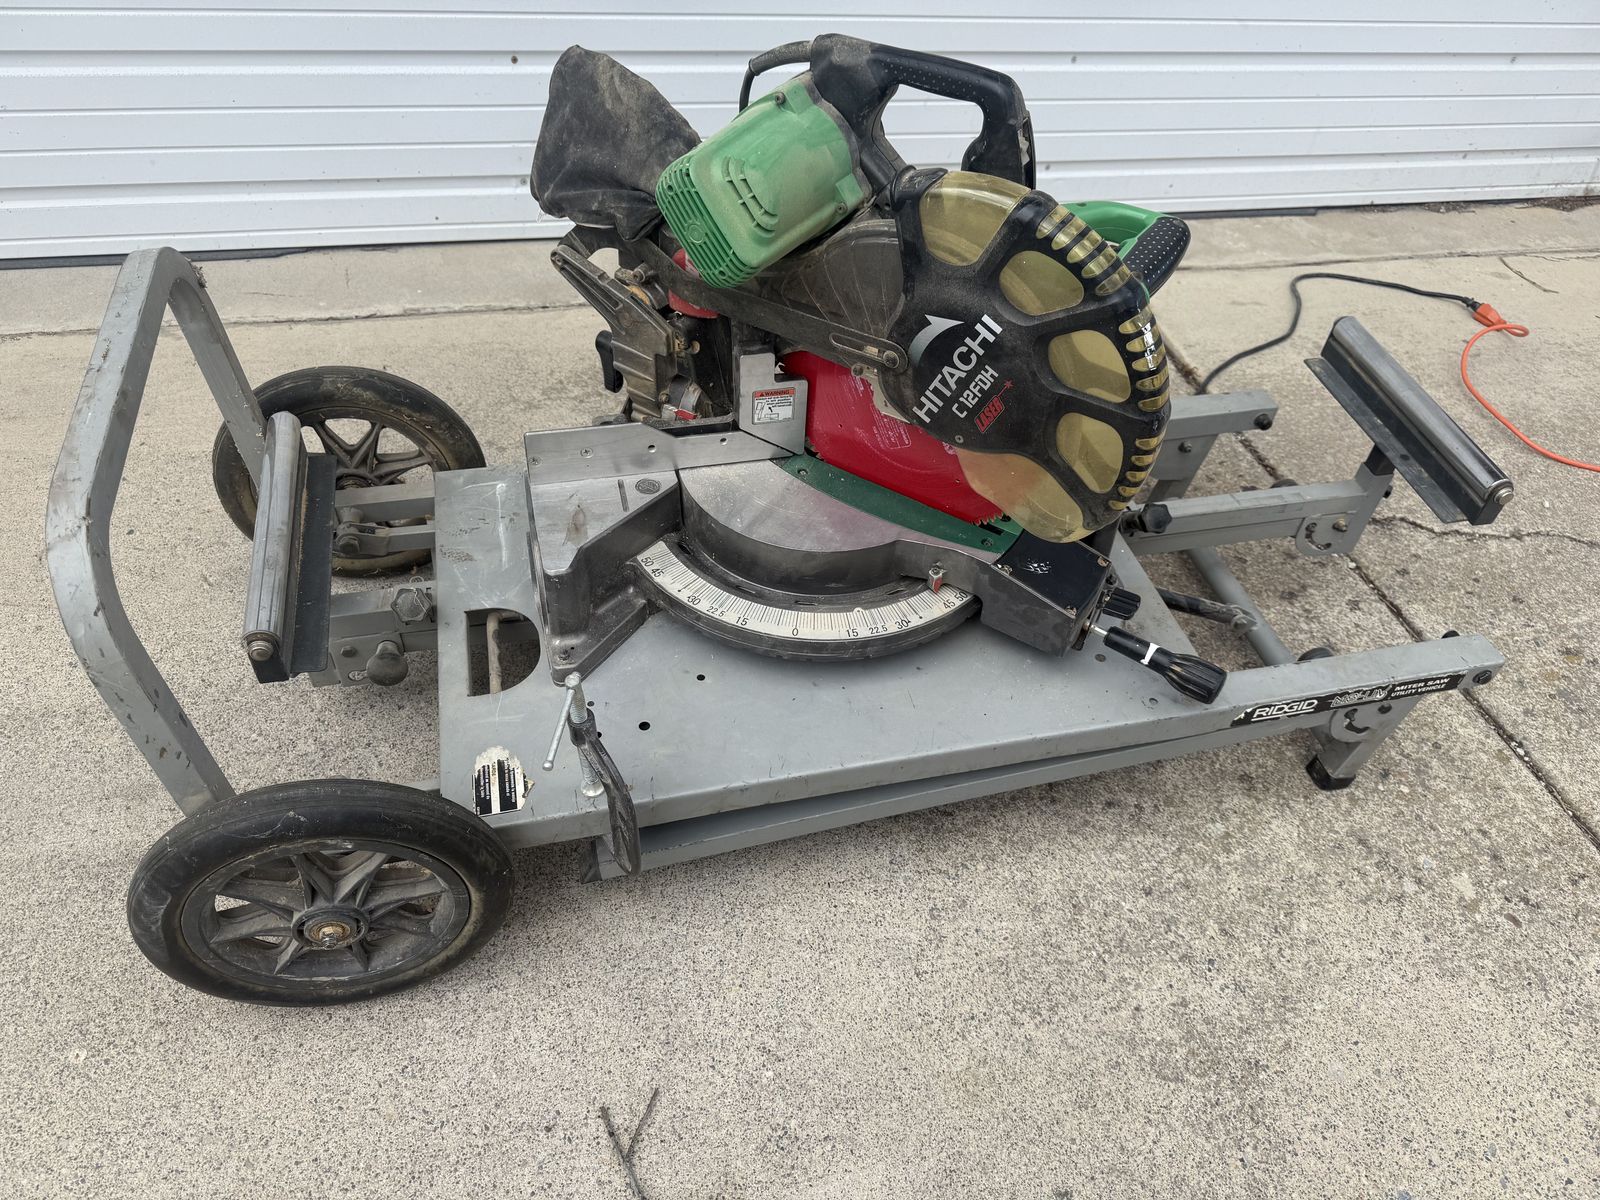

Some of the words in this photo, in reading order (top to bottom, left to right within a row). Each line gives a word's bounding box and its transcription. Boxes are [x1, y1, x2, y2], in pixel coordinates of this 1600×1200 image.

[912, 314, 1003, 424] HITACHI
[959, 365, 999, 408] 12FDH
[952, 403, 967, 418] C
[976, 396, 1004, 432] LASER
[641, 556, 655, 567] 50
[651, 568, 665, 577] 45
[687, 595, 701, 605] 30
[706, 606, 726, 617] 22.5
[735, 616, 749, 626] 15
[791, 627, 799, 636] 0
[846, 628, 859, 637] 15
[869, 624, 888, 634] 22.5
[895, 619, 909, 629] 30
[943, 599, 956, 609] 45
[954, 591, 968, 601] 50
[1391, 688, 1417, 697] UTILITY
[1418, 683, 1446, 693] VEHICLE
[1394, 682, 1425, 692] MITER
[1427, 678, 1451, 686] SAW
[1252, 699, 1319, 719] RIDGID
